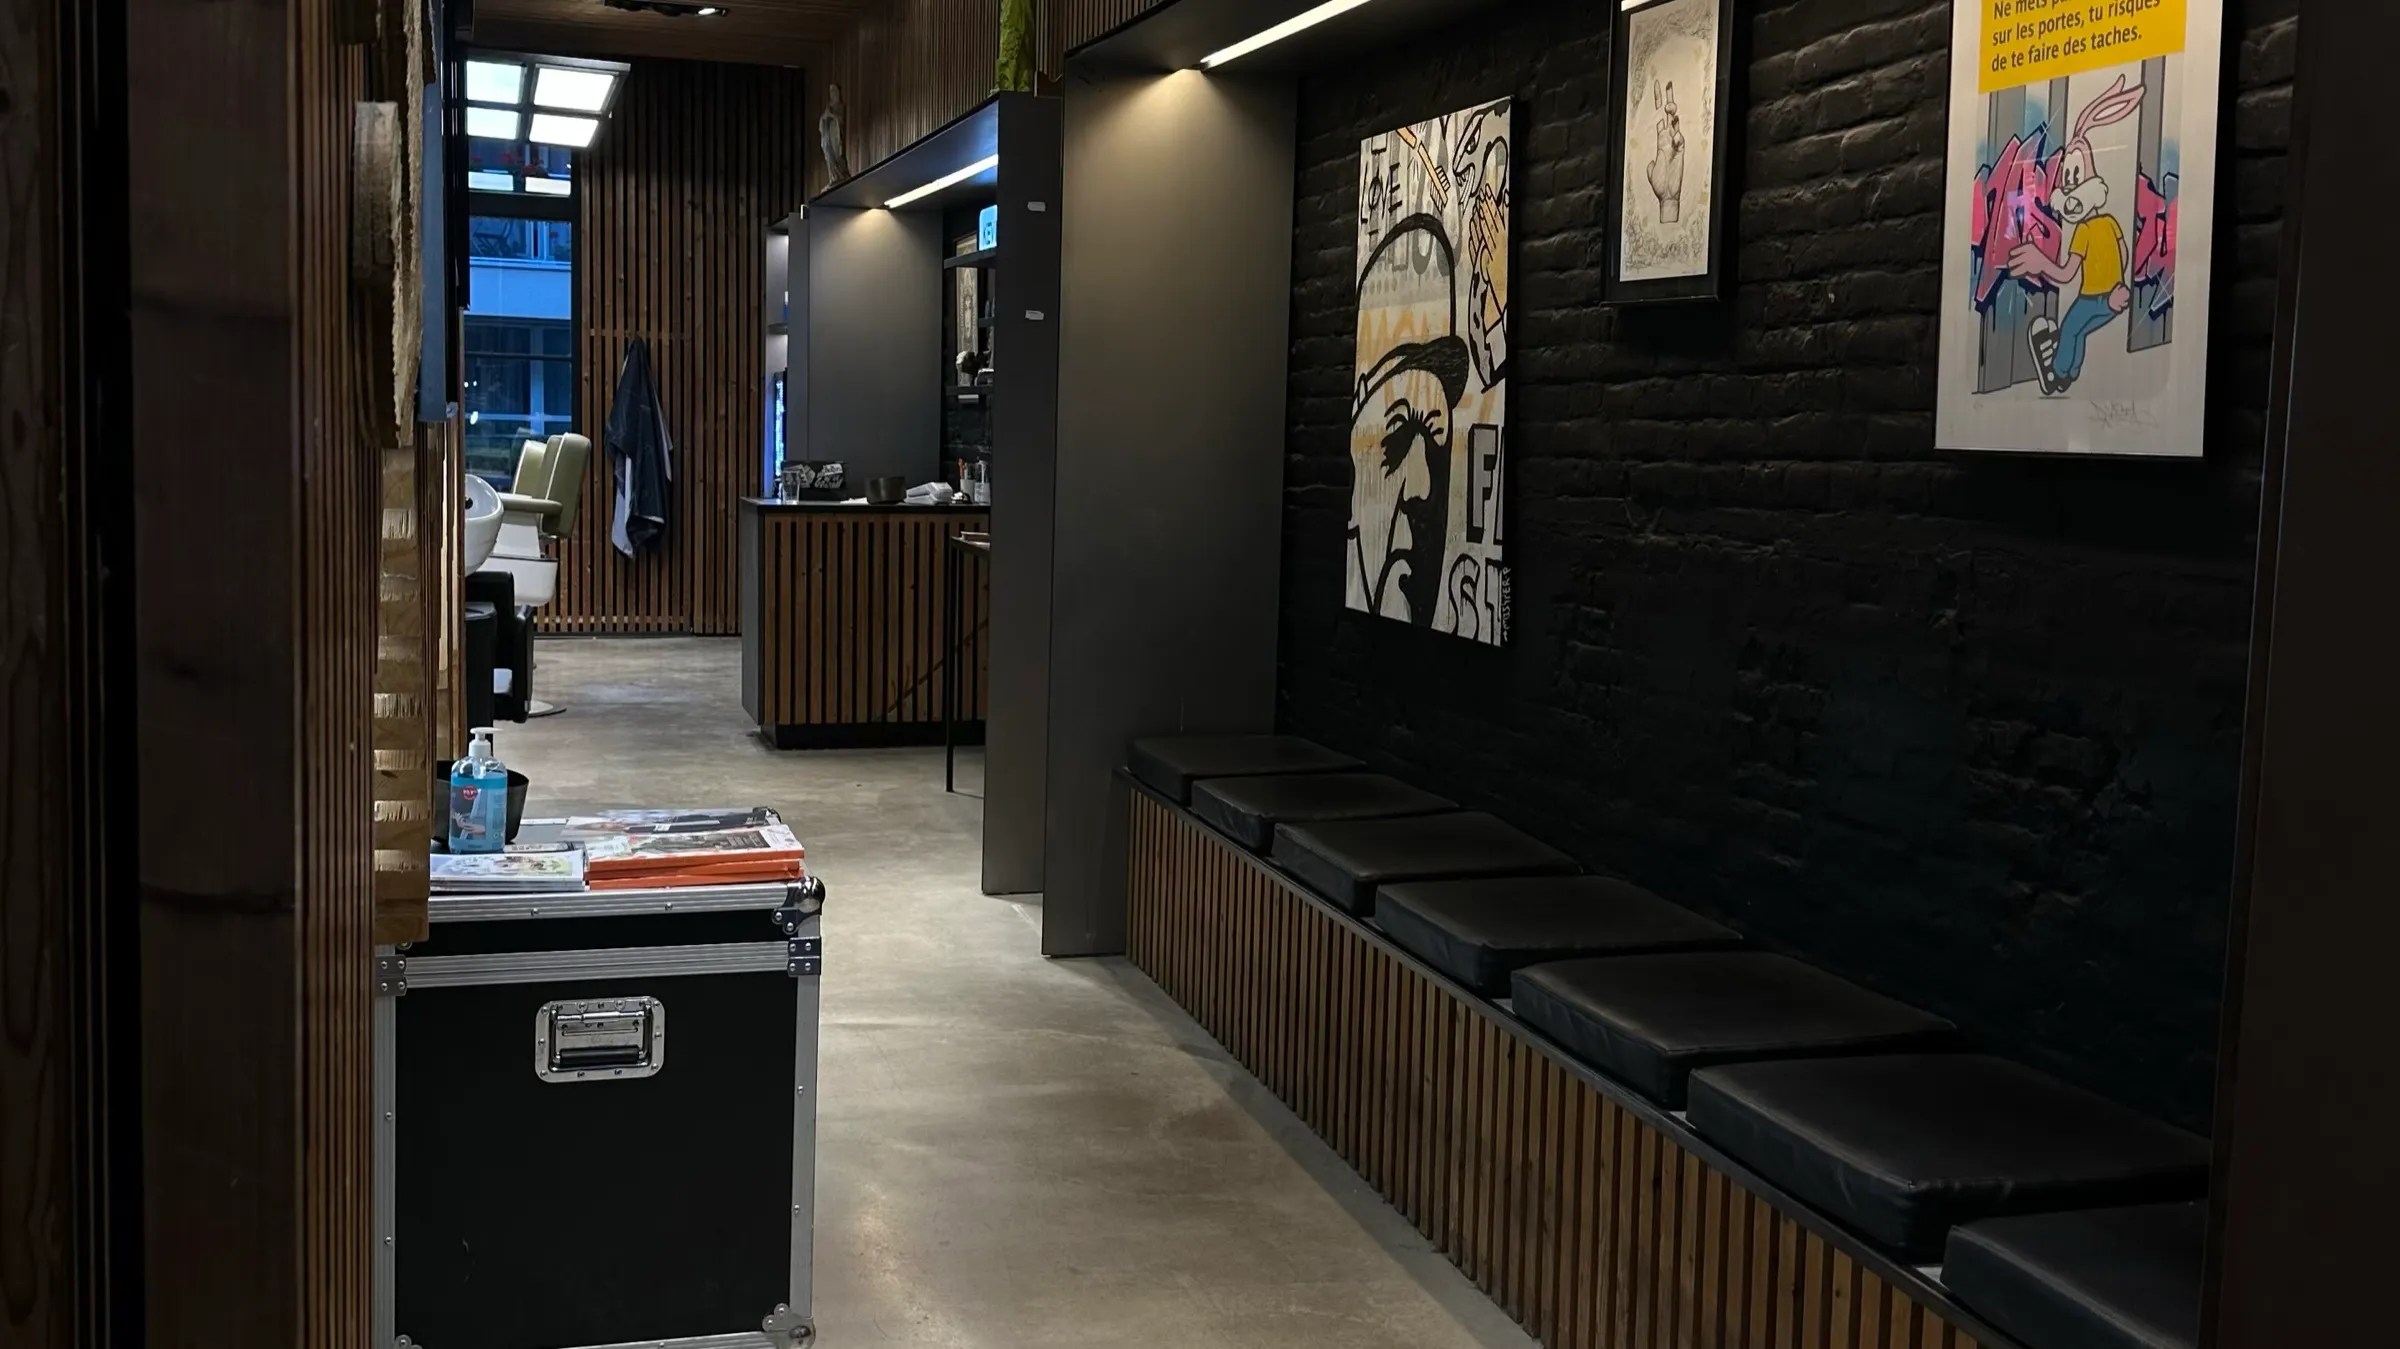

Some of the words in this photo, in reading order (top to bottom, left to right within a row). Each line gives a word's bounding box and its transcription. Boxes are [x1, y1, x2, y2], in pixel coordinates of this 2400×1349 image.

[1993, 29, 2012, 46] sur
[2016, 23, 2034, 40] les
[2038, 12, 2084, 39] portes,
[2089, 6, 2103, 23] tu
[2108, 0, 2160, 18] risques
[1994, 3, 2011, 19] Ne
[2015, 0, 2047, 14] mets
[1991, 54, 2007, 72] de
[2011, 51, 2024, 68] te
[2028, 43, 2059, 64] faire
[2063, 36, 2087, 55] des
[2091, 25, 2142, 50] taches.
